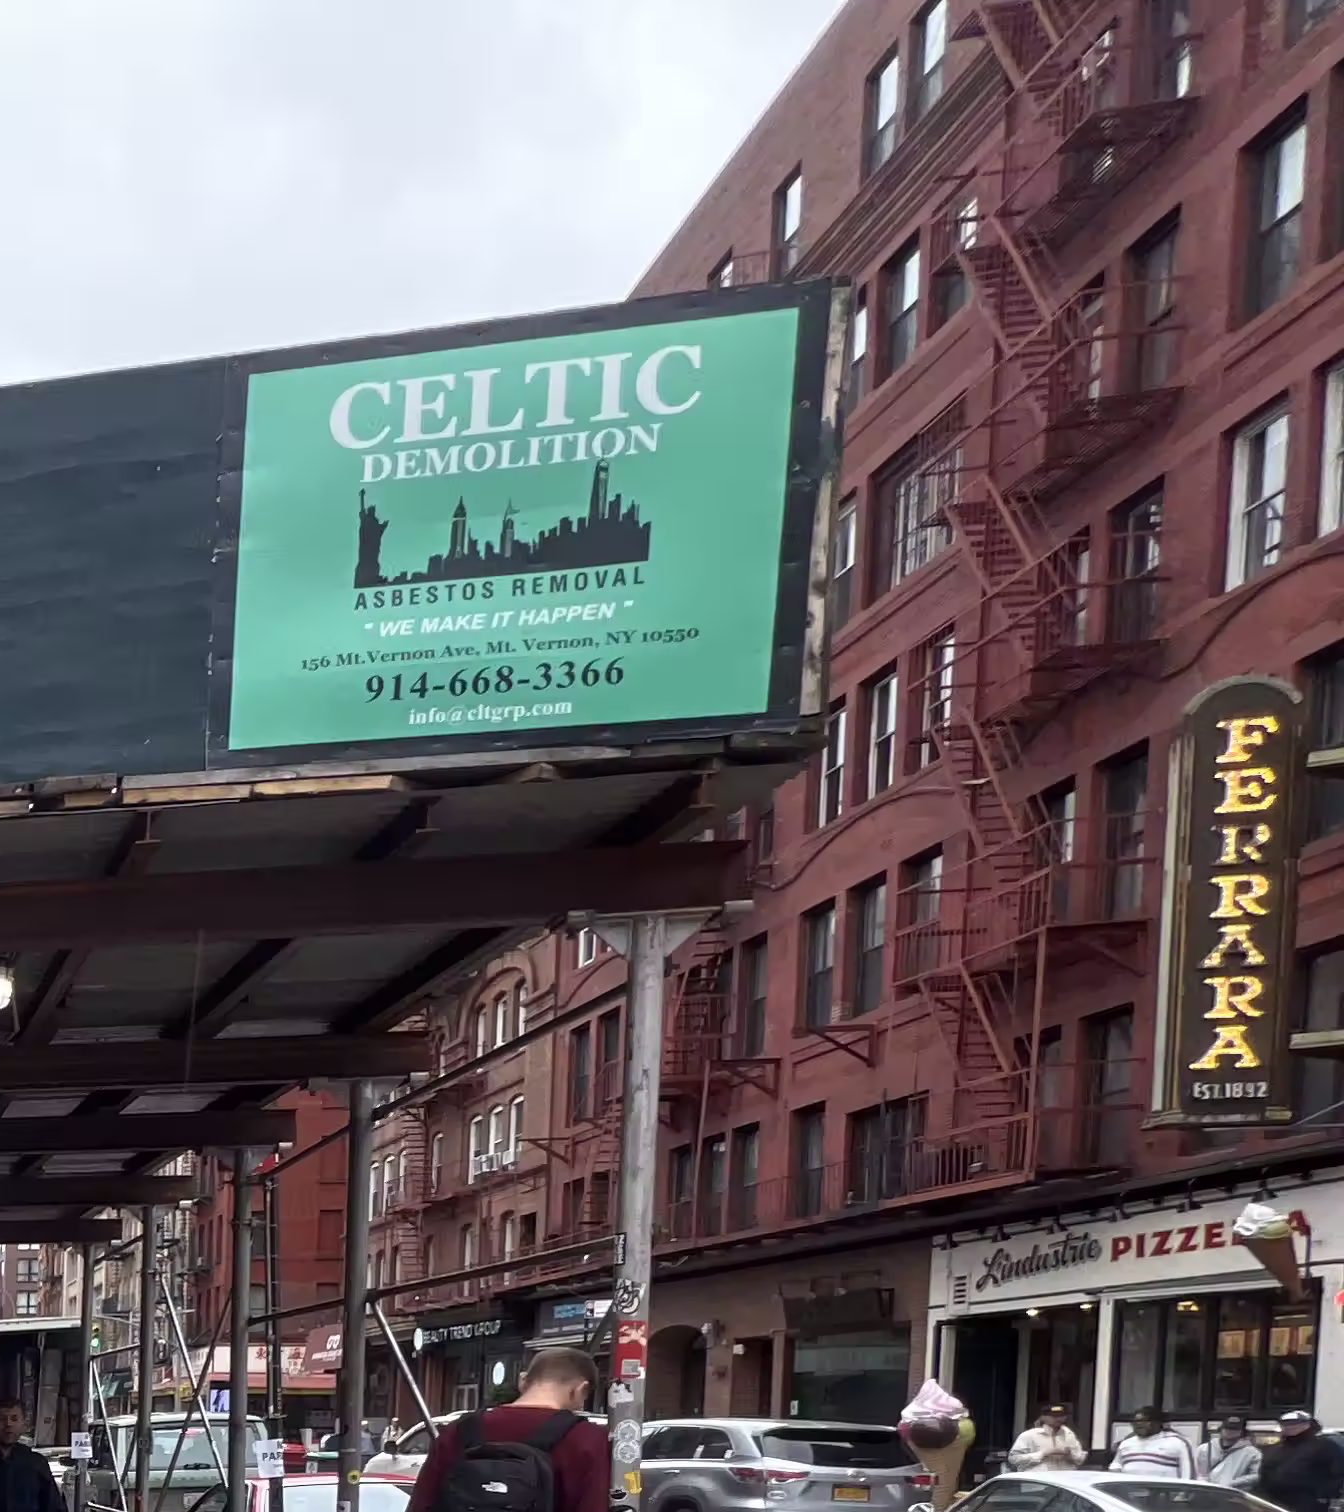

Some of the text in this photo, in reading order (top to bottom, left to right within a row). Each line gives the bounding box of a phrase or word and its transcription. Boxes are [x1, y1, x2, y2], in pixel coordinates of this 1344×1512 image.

[328, 345, 703, 451] CELTIC
[360, 423, 662, 484] DEMOLITION
[354, 566, 646, 611] ASBESTOS REMOVAL
[420, 614, 486, 634] MAKE
[490, 610, 514, 629] IT
[301, 655, 331, 671] 156
[605, 629, 637, 647] NY
[641, 625, 700, 644] 10550
[364, 655, 626, 704] 914-668-3366
[408, 700, 572, 726] info@cltgrp.com
[1189, 714, 1281, 1071] FERRARA
[1110, 1209, 1306, 1263] PIZZEA
